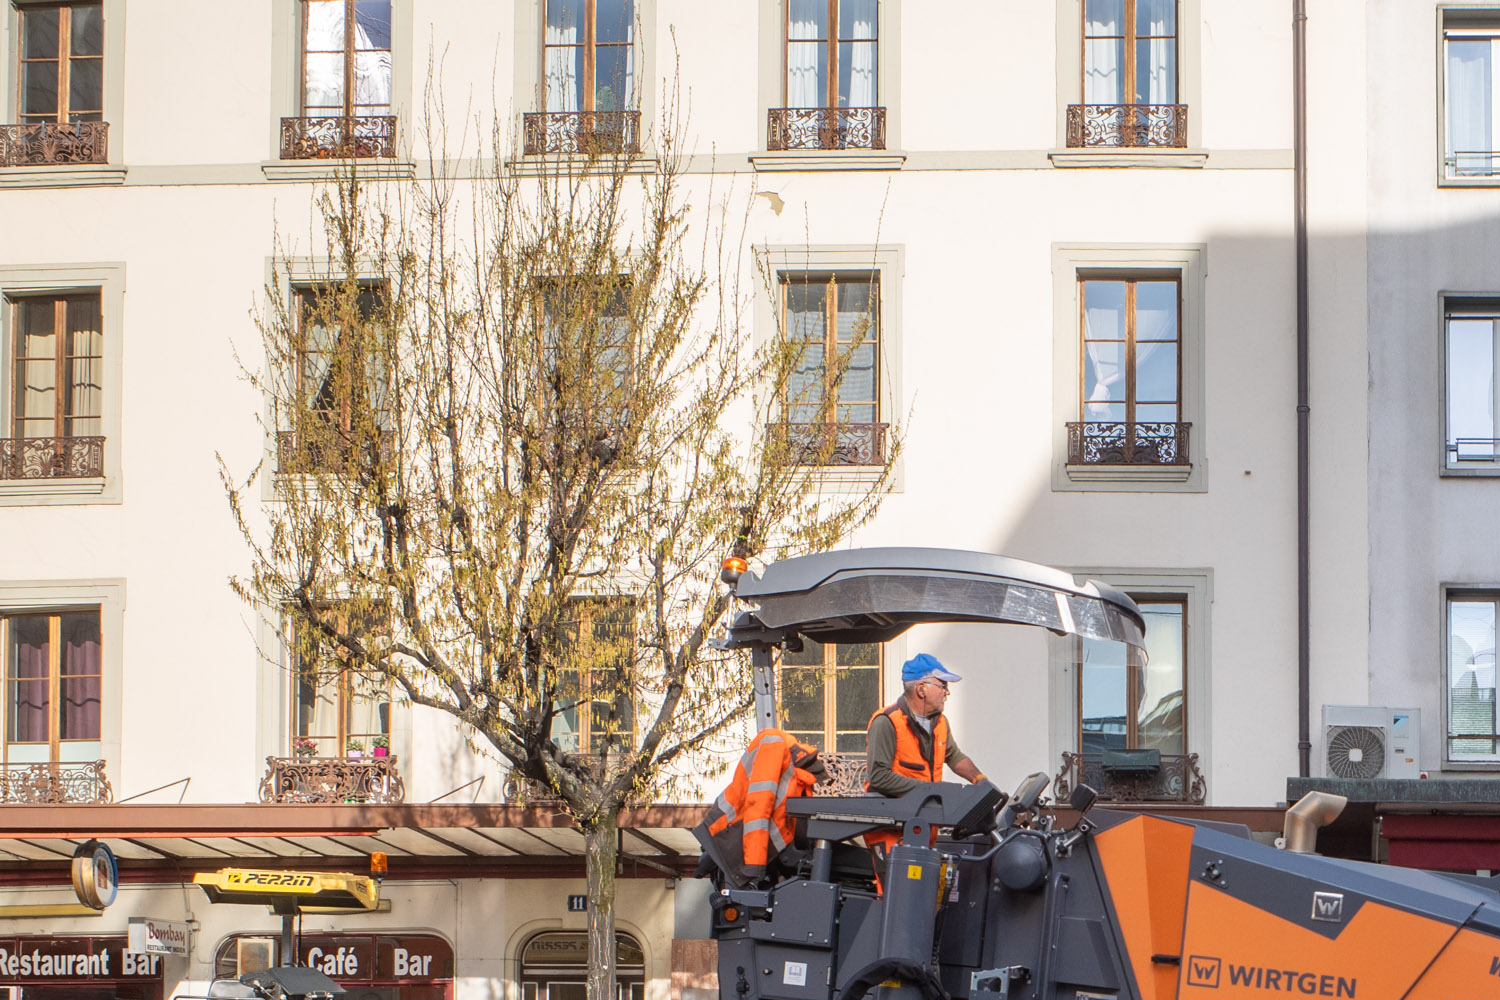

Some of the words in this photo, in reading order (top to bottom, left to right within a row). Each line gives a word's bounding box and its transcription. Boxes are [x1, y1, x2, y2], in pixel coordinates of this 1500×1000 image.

[244, 873, 314, 886] PERRIN
[573, 896, 584, 910] 11
[148, 922, 185, 946] Bombay
[0, 948, 109, 976] Restaurant
[122, 947, 160, 975] Bar
[308, 946, 358, 976] Café
[394, 948, 433, 976] Bar
[1229, 964, 1357, 1000] WIRTGEN
